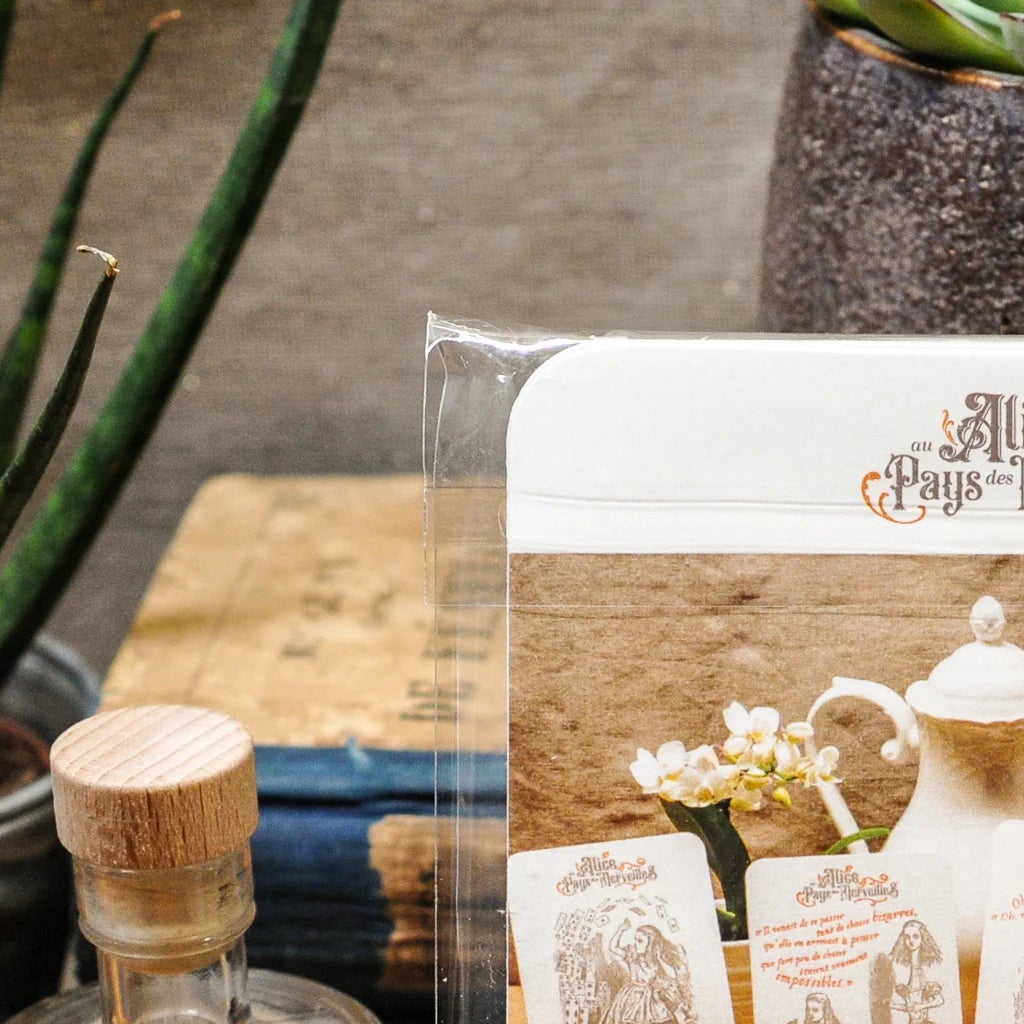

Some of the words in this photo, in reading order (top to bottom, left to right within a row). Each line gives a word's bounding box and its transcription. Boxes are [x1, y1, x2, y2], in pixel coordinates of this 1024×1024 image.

[911, 440, 933, 453] au
[884, 453, 983, 516] Pays
[986, 470, 1013, 486] des
[577, 856, 618, 877] Alice
